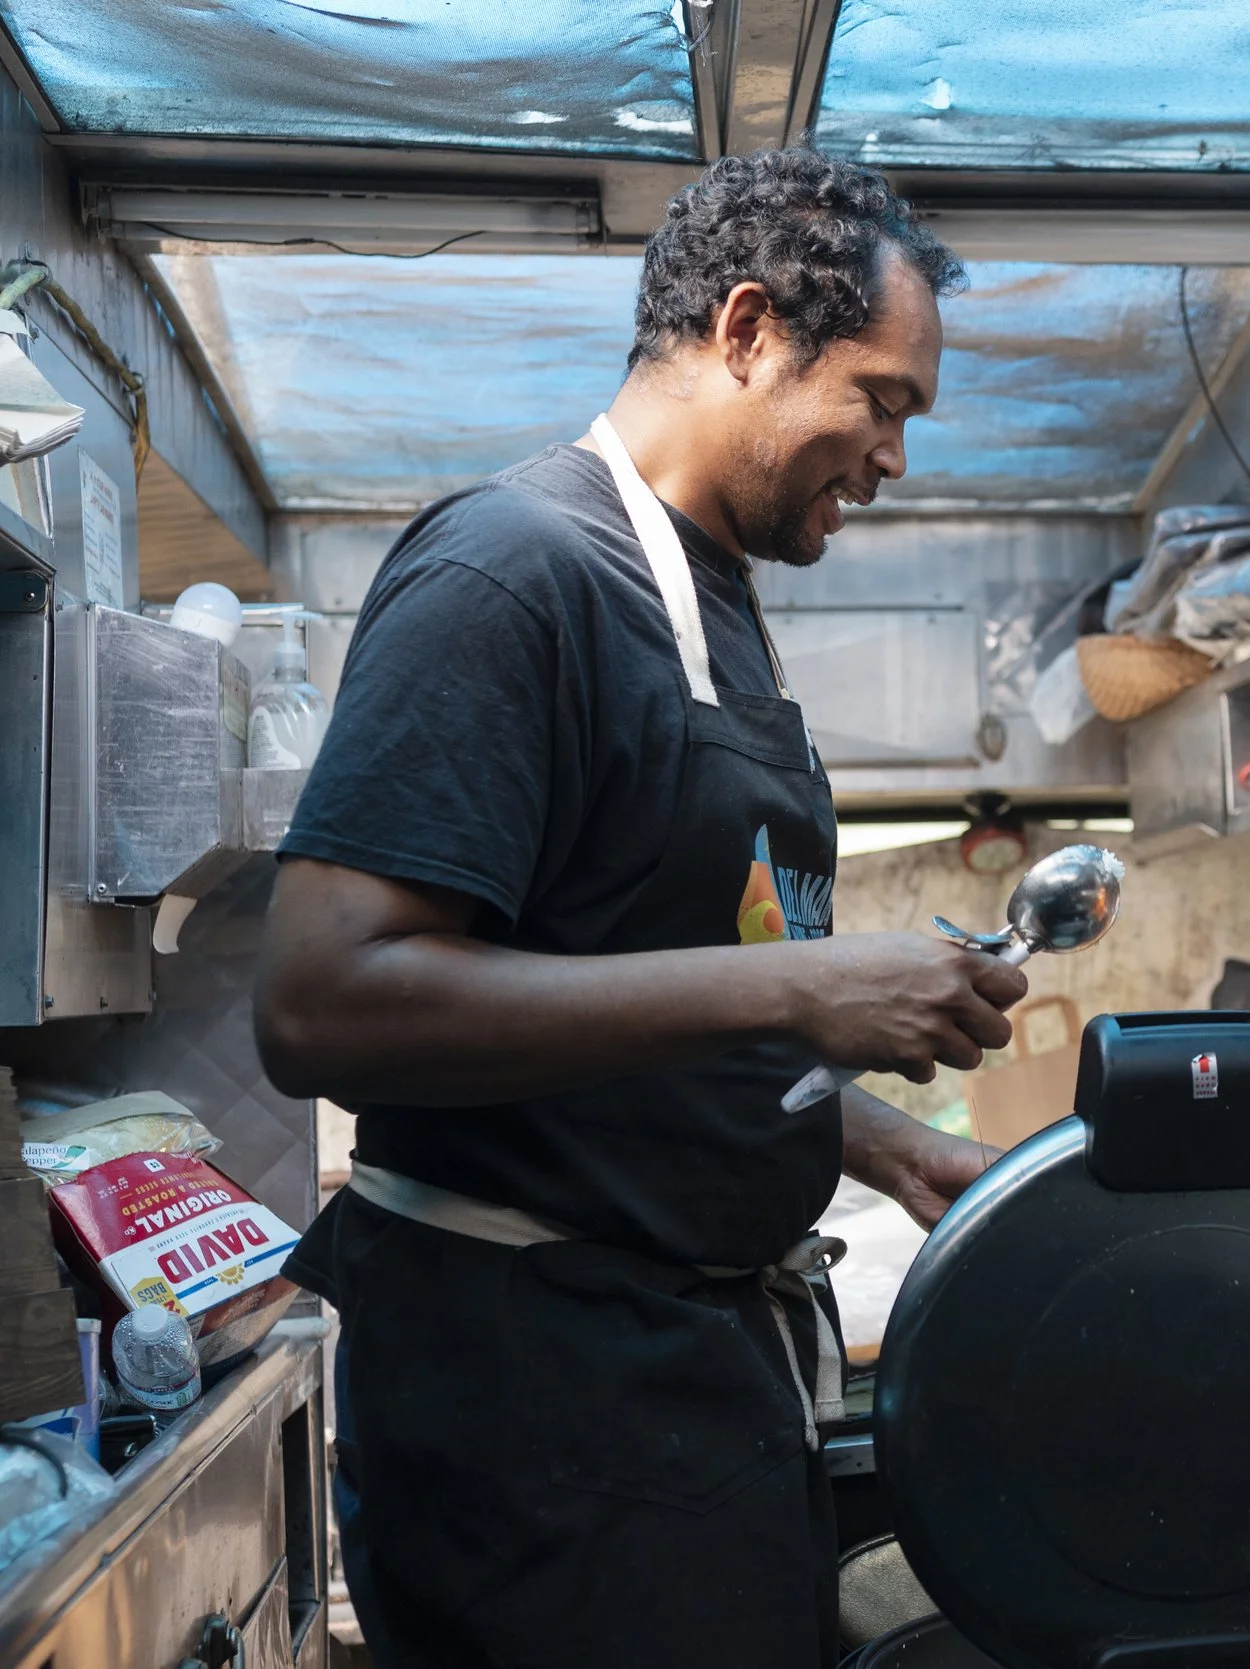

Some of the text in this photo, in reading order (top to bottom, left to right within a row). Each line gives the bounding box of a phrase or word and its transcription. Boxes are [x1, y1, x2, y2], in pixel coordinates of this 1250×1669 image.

[21, 1146, 66, 1157] alapeño
[134, 1179, 158, 1195] SEEDS
[121, 1187, 176, 1216] ROASTED
[135, 1188, 232, 1233] ORIGINAL
[155, 1236, 174, 1249] BRAND
[175, 1229, 189, 1241] SEED
[157, 1218, 270, 1284] DAVID
[137, 1281, 167, 1303] BAGS
